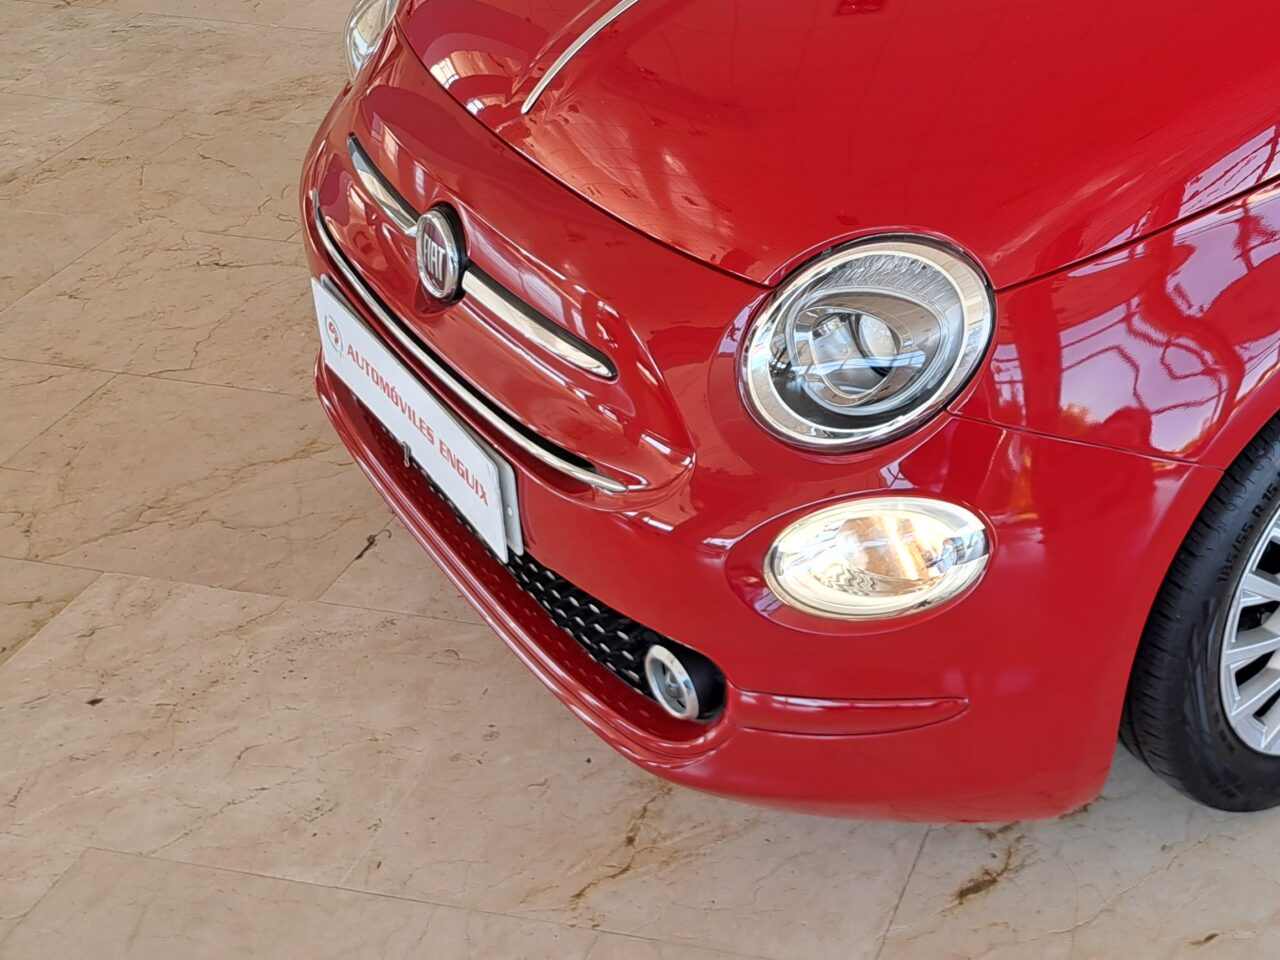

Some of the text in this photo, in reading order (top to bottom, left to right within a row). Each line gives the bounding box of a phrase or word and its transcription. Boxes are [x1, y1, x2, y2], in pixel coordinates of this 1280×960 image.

[424, 232, 446, 282] FIAT
[347, 343, 488, 507] AUTOMÓVILES ENGUIX
[1216, 522, 1255, 584] 185/55
[1251, 504, 1265, 519] R
[1262, 483, 1279, 502] 15
